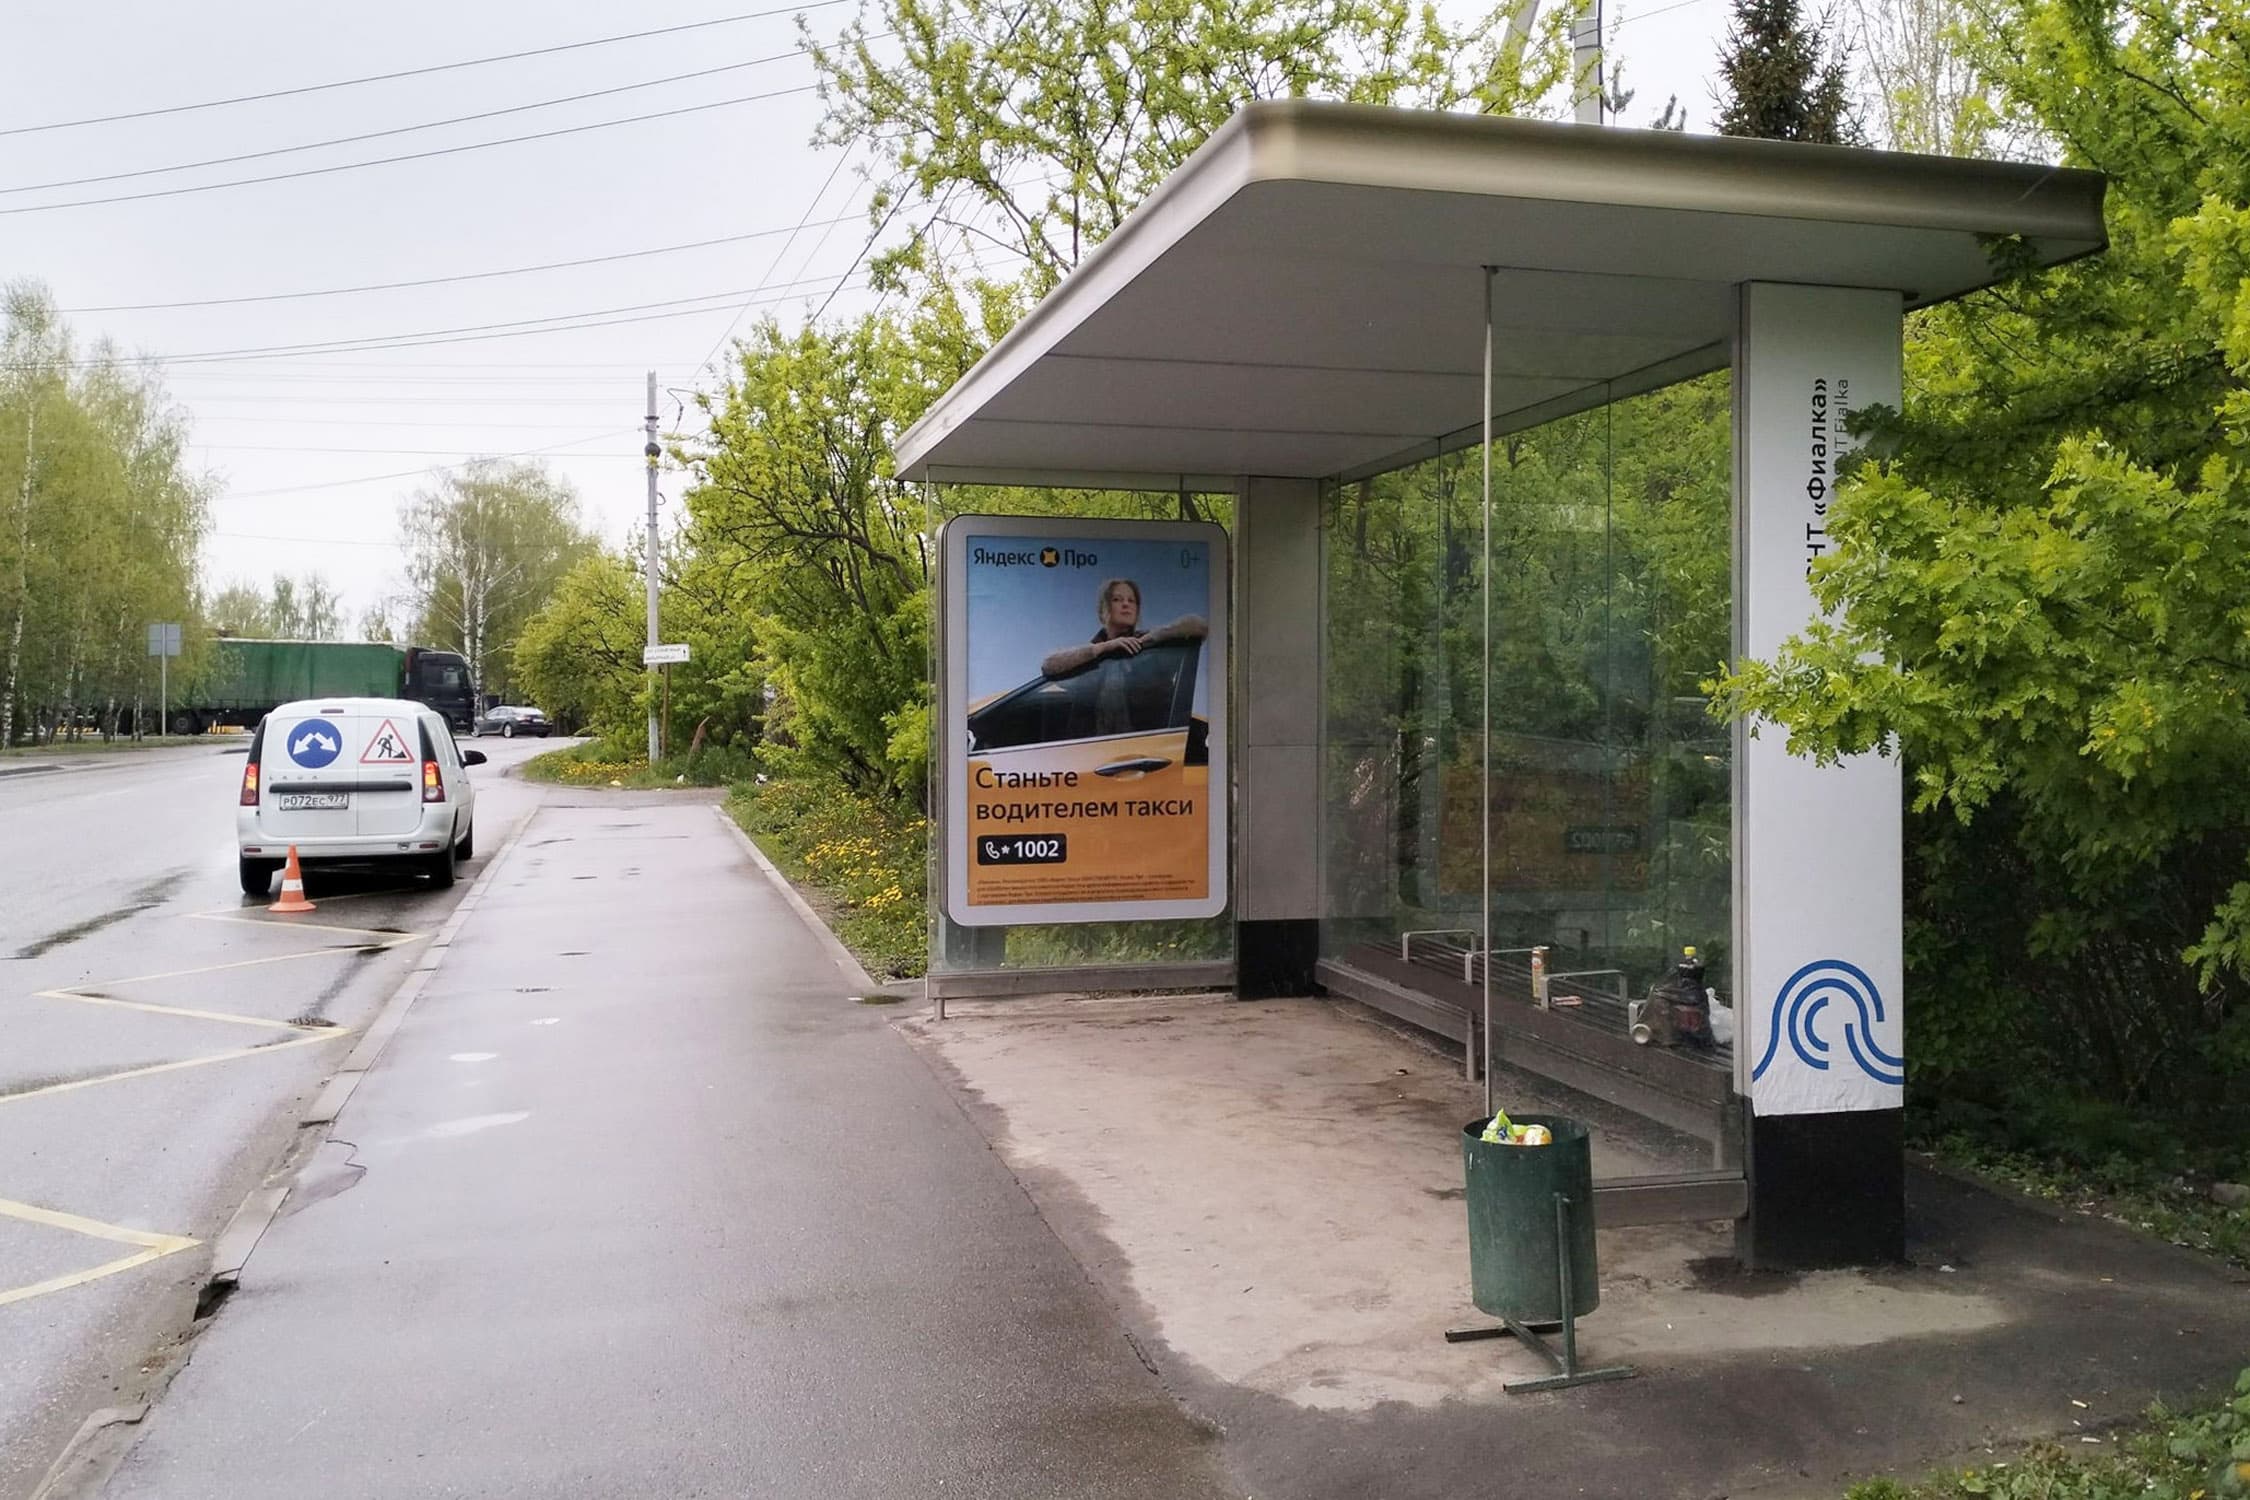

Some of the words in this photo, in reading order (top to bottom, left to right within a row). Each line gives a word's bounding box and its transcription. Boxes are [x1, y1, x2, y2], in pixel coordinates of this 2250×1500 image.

[1833, 379, 1849, 433] Fialka
[1806, 378, 1827, 516] «Фиалка»
[973, 548, 1036, 567] Яндекс
[1064, 550, 1098, 568] Про
[1180, 550, 1201, 569] 0+
[975, 767, 1079, 789] Станьте
[976, 801, 1118, 824] водителем
[1125, 799, 1193, 817] такси
